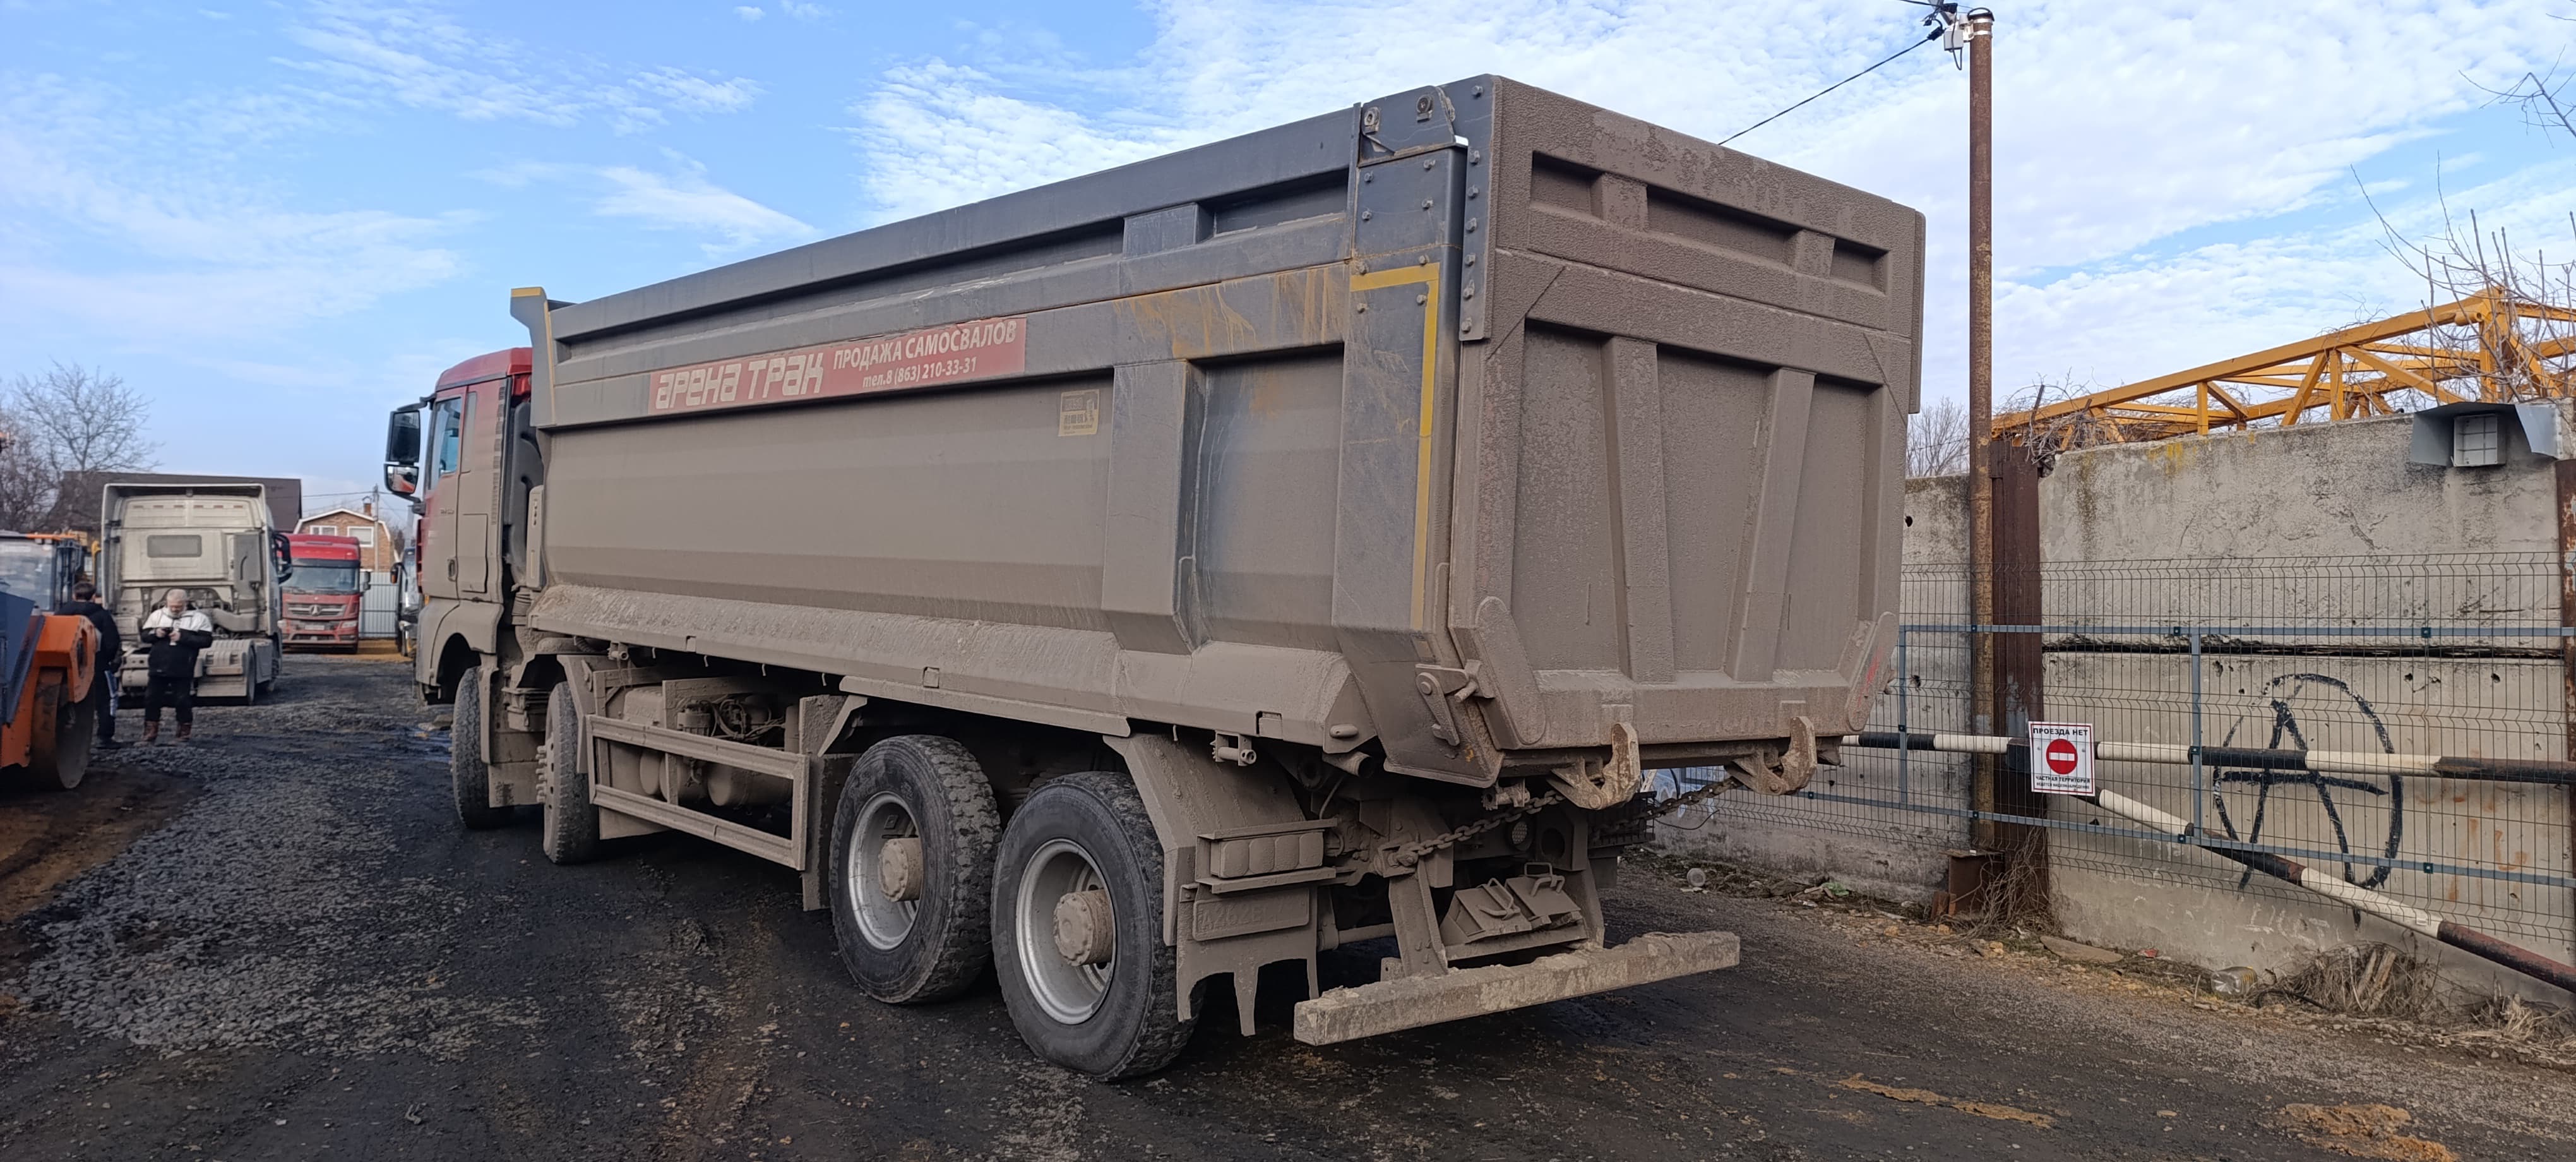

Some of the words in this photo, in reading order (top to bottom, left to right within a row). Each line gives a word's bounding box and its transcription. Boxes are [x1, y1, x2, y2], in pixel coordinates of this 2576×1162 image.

[833, 340, 902, 371] ПРОДАЖА
[905, 320, 1017, 359] САМОСВАЛОВ
[894, 364, 921, 385] (863)
[922, 356, 977, 380] 210-33-31
[2033, 728, 2070, 736] ПРОЕЗДА
